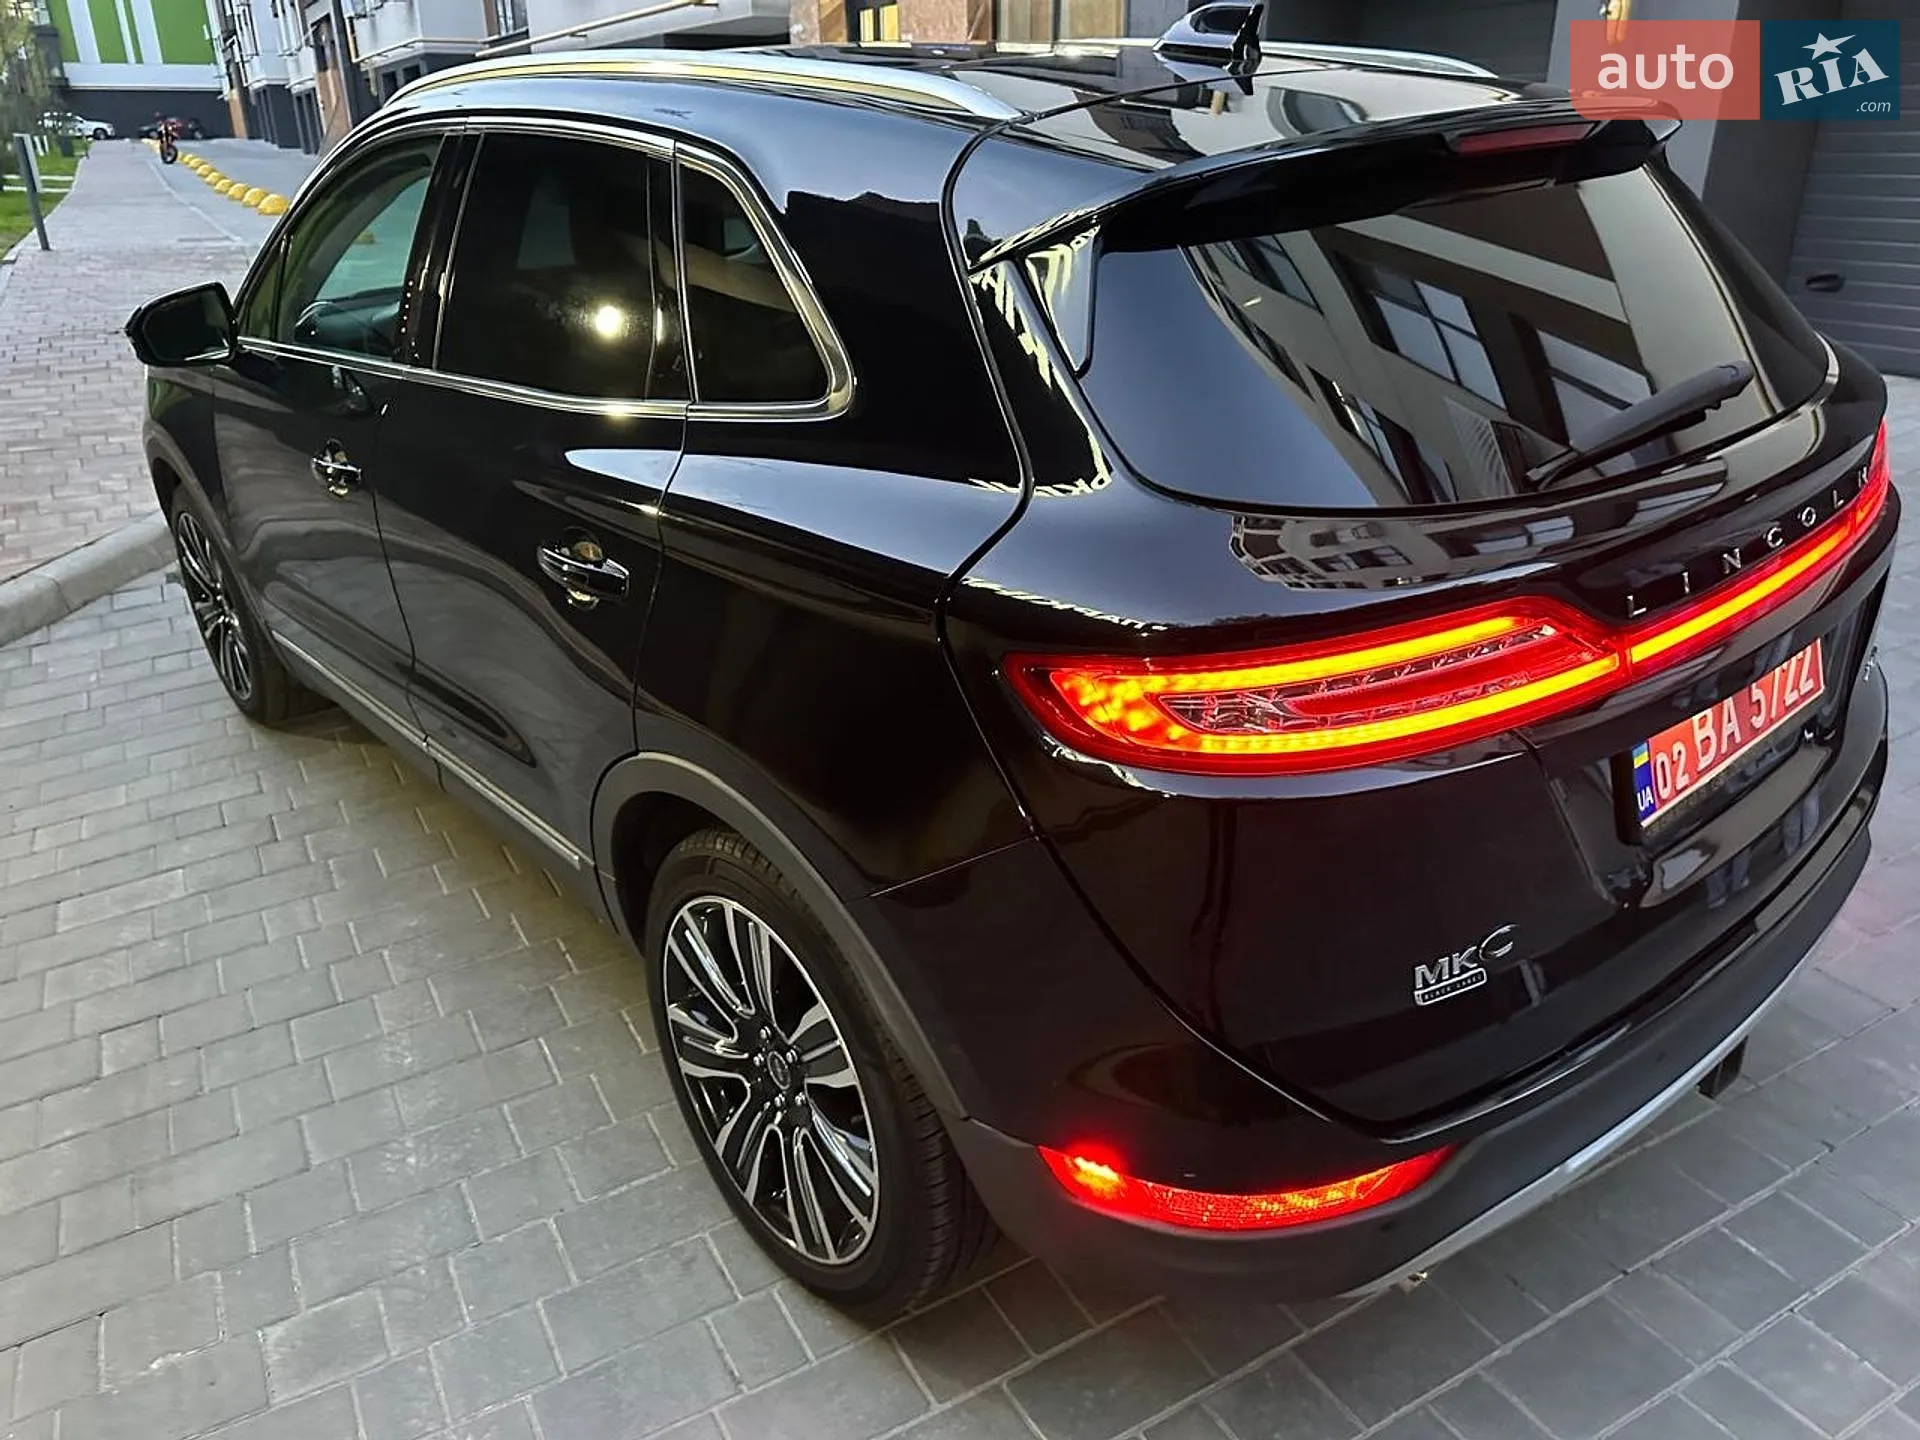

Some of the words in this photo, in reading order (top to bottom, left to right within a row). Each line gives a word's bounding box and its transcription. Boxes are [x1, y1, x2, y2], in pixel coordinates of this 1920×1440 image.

[1627, 466, 1869, 619] LINCOLN
[1655, 743, 1691, 799] 02
[1692, 697, 1742, 772] BA
[1637, 787, 1654, 811] UA
[1414, 924, 1519, 989] MKC
